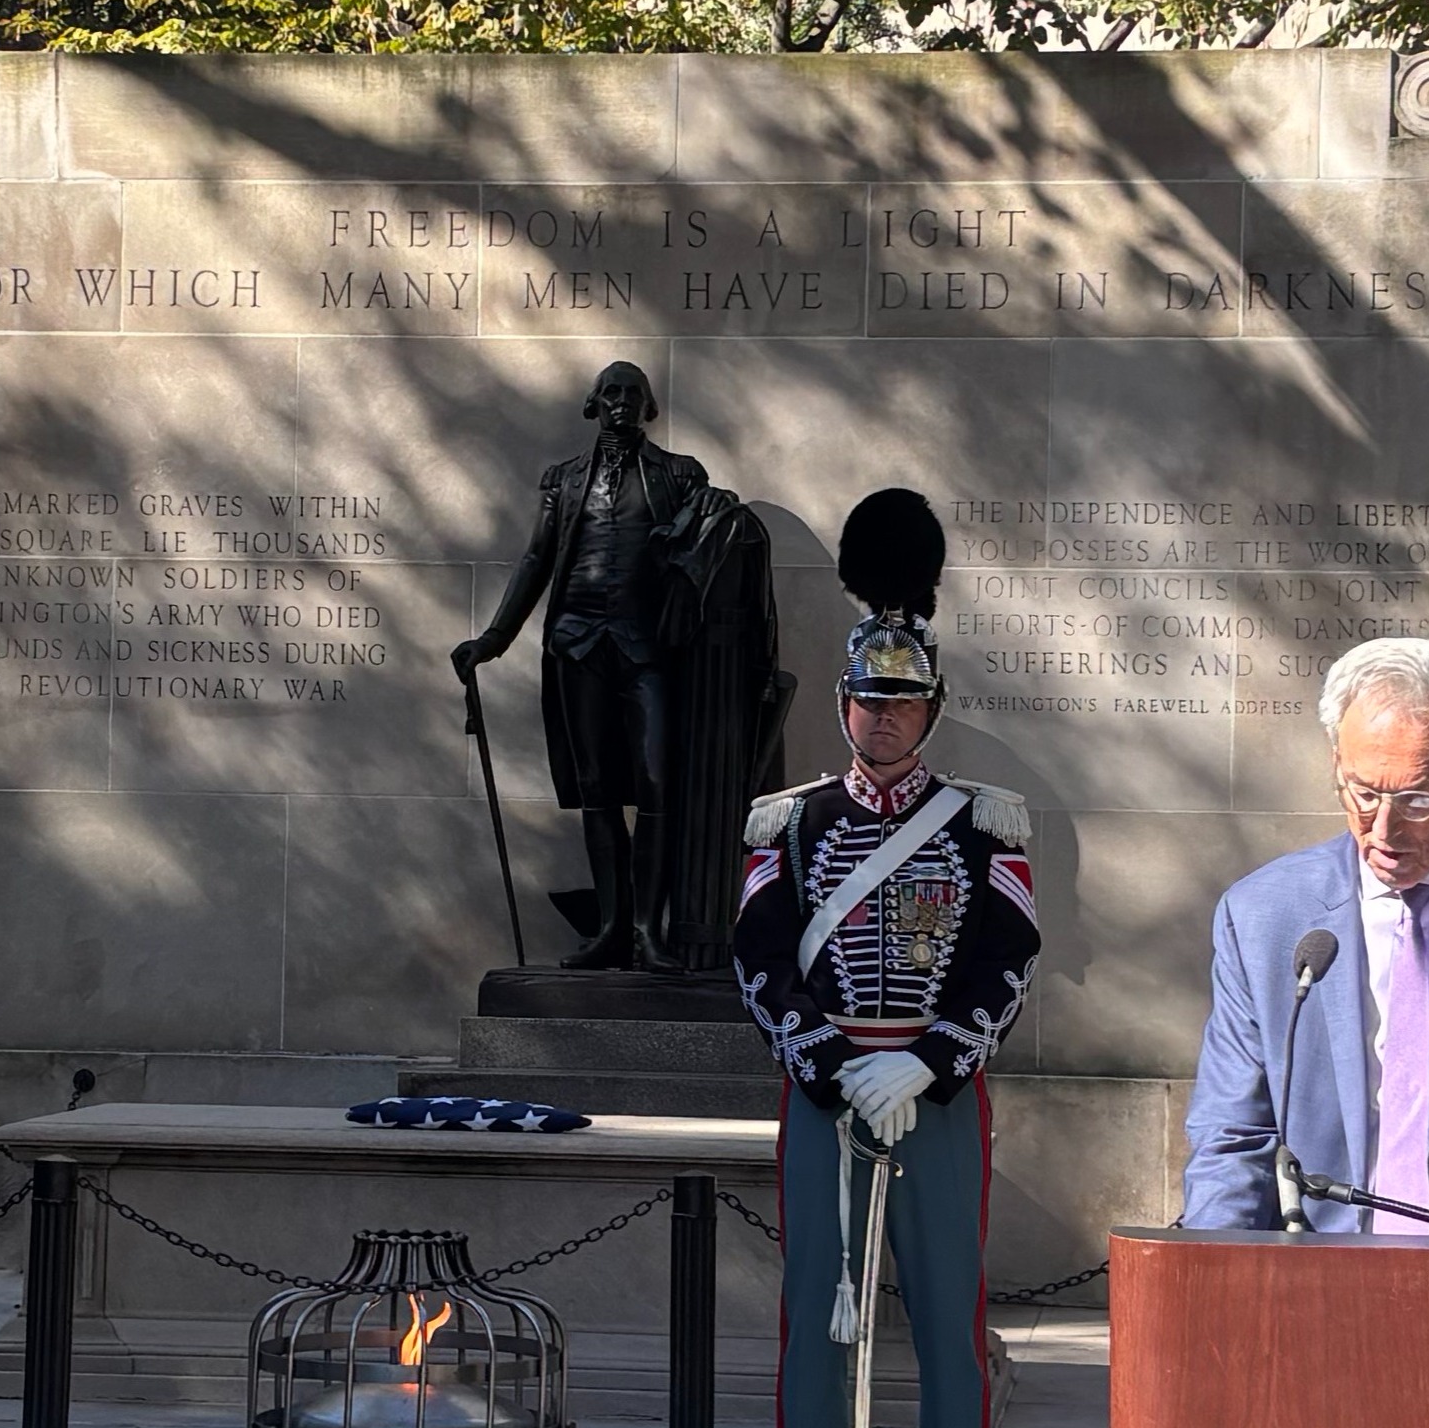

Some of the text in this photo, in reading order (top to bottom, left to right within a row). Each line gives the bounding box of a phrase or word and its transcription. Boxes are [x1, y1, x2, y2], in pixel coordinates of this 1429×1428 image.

[329, 209, 1027, 249] FREEDOM IS A LIGHT
[74, 267, 261, 308] WHICH
[320, 271, 471, 310] MANY
[524, 272, 632, 310] MEN
[682, 272, 823, 311] HAVE
[879, 272, 1010, 310] DIED
[1054, 271, 1108, 311] IN
[139, 494, 244, 517] GRAVES
[268, 496, 381, 519] WITHIN
[950, 501, 1003, 523] THE
[1018, 501, 1233, 525] INDEPENDENCE
[1252, 503, 1315, 526] AND
[0, 528, 114, 554] SQUARE
[144, 531, 187, 553] LIE
[212, 532, 386, 555] THOUSANDS
[964, 538, 1019, 562] YOU
[1032, 539, 1150, 562] POSSESS
[1163, 540, 1218, 563] ARE
[1235, 541, 1291, 564] THE
[1308, 541, 1391, 565] WORK
[163, 567, 305, 591] SOLDIERS
[327, 569, 362, 591] OF
[973, 576, 1422, 606] JOINT COUNCILS AND JOINT
[147, 604, 224, 626] ARMY
[237, 605, 302, 628] WHO
[316, 606, 381, 628] DIED
[1142, 614, 1275, 640] COMMON
[75, 639, 133, 661] AND
[147, 640, 270, 664] SICKNESS
[285, 642, 386, 666] DURING
[985, 650, 1169, 676] SUFFERINGS
[1190, 653, 1253, 678] AND
[20, 674, 264, 700] REVOLUTIONARY
[283, 679, 347, 701] WAR
[958, 695, 1303, 716] WASHINGTON'S FAREWELL ADDRESS
